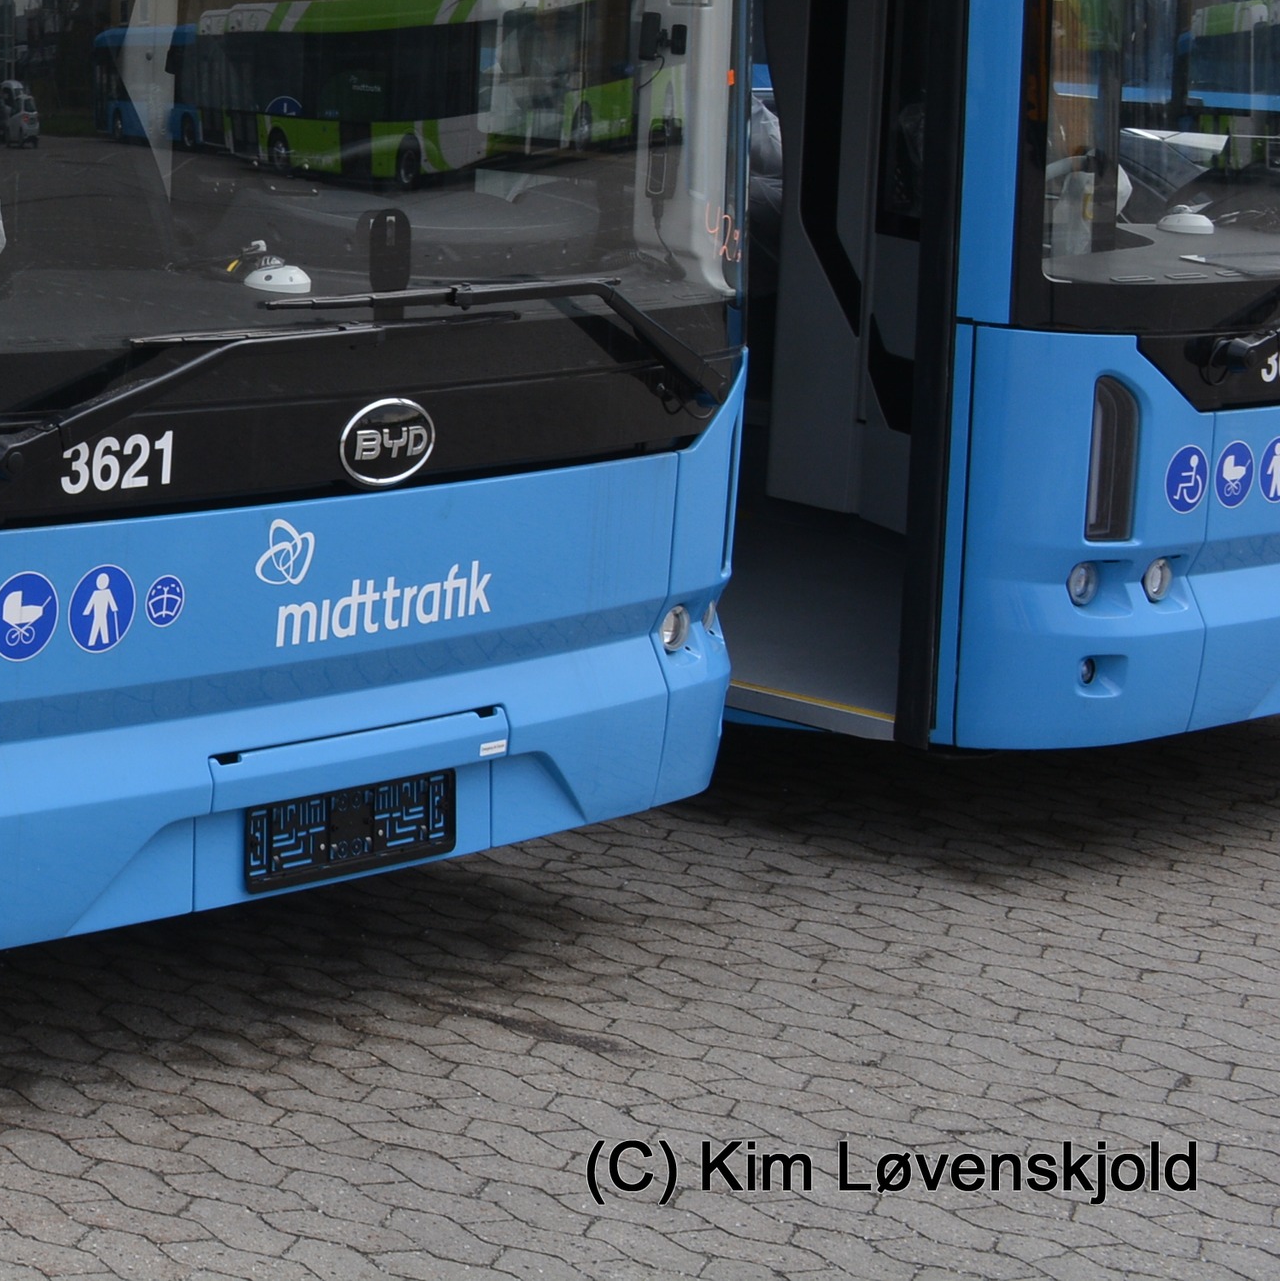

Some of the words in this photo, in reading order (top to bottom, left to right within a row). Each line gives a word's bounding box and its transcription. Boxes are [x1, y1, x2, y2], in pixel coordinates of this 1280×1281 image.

[60, 430, 174, 494] 3621
[354, 425, 428, 461] BYD
[275, 560, 492, 648] midttrafik
